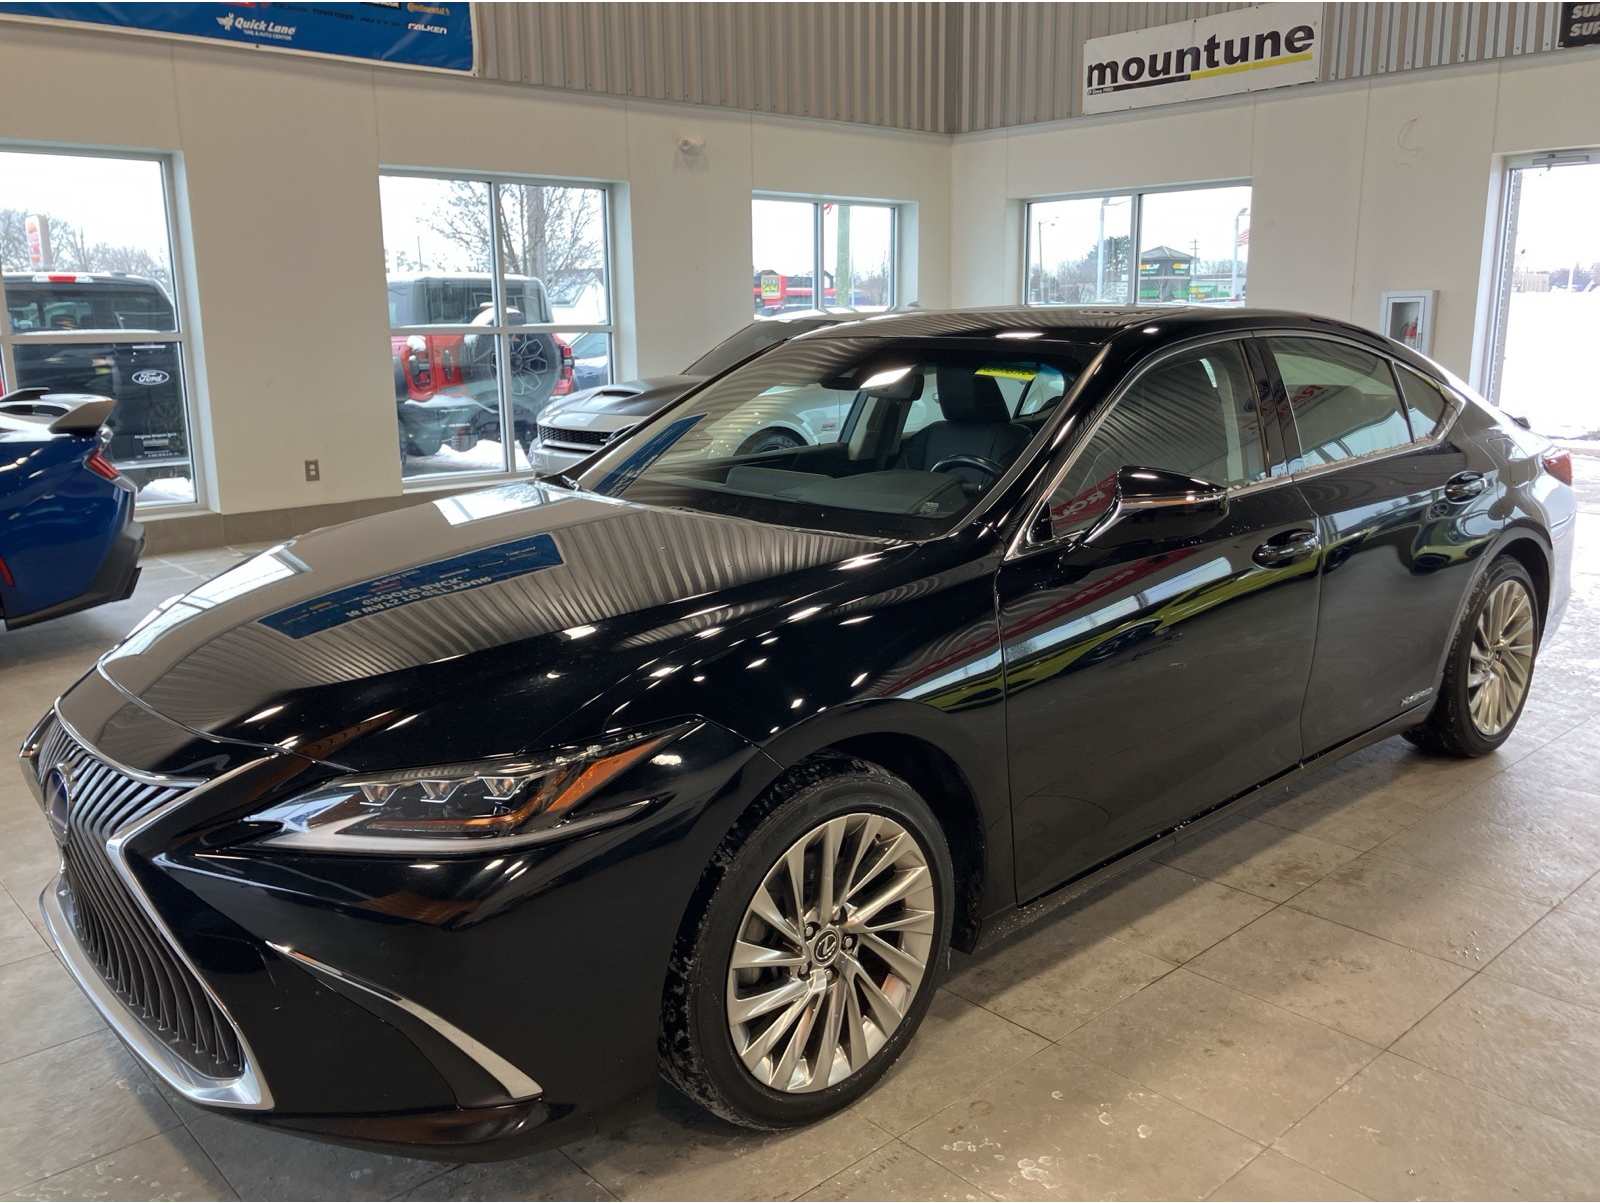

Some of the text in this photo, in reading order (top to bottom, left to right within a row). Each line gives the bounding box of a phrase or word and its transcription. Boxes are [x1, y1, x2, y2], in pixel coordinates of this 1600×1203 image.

[235, 16, 296, 36] Quick Lane
[408, 22, 447, 35] FALKEN
[1087, 24, 1315, 88] mountune
